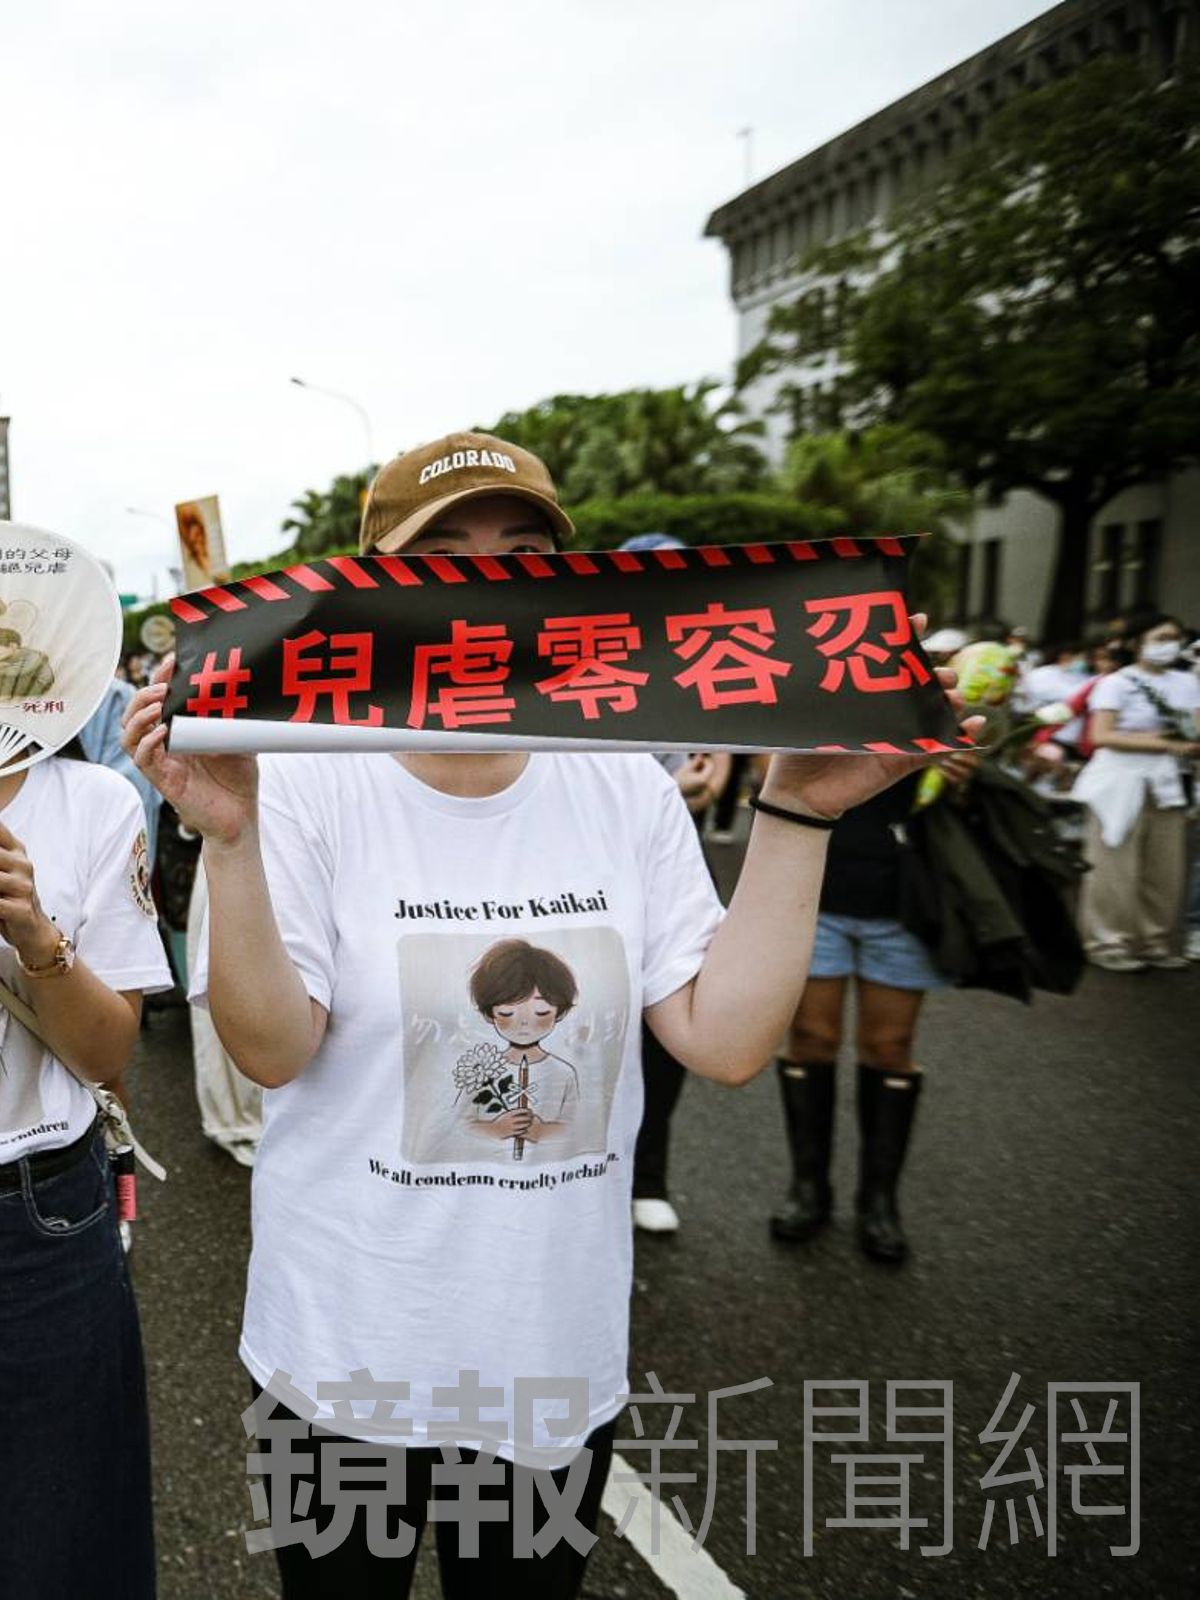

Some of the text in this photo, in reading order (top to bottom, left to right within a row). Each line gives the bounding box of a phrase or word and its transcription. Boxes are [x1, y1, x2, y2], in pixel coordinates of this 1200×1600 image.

[419, 449, 517, 485] COLORADO
[185, 588, 932, 730] #兒虐零容忍
[394, 890, 608, 920] Justice For Kaikai
[368, 1159, 389, 1179] We
[391, 1170, 412, 1186] all
[415, 1172, 495, 1187] condemn
[498, 1173, 557, 1190] cruelty
[561, 1171, 574, 1184] to
